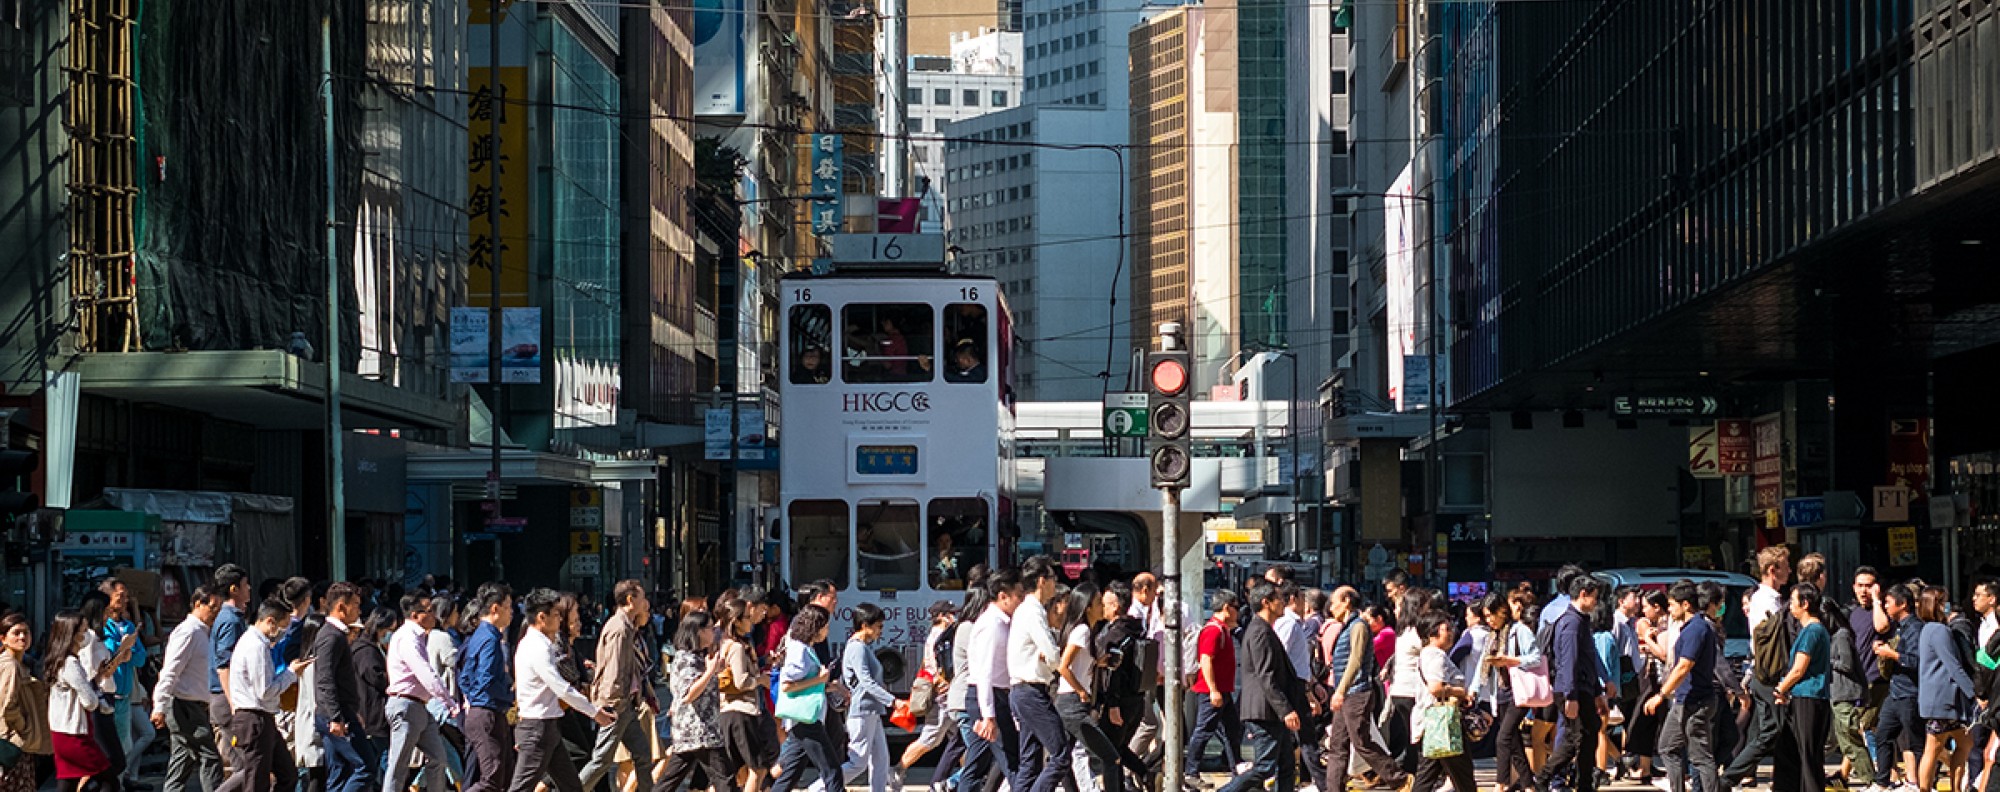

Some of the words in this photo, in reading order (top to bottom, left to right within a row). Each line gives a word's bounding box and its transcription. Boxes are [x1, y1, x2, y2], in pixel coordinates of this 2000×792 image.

[872, 235, 903, 260] 16
[794, 288, 811, 302] 16
[960, 287, 978, 300] 16
[1879, 490, 1906, 507] FT
[883, 607, 902, 621] OF
